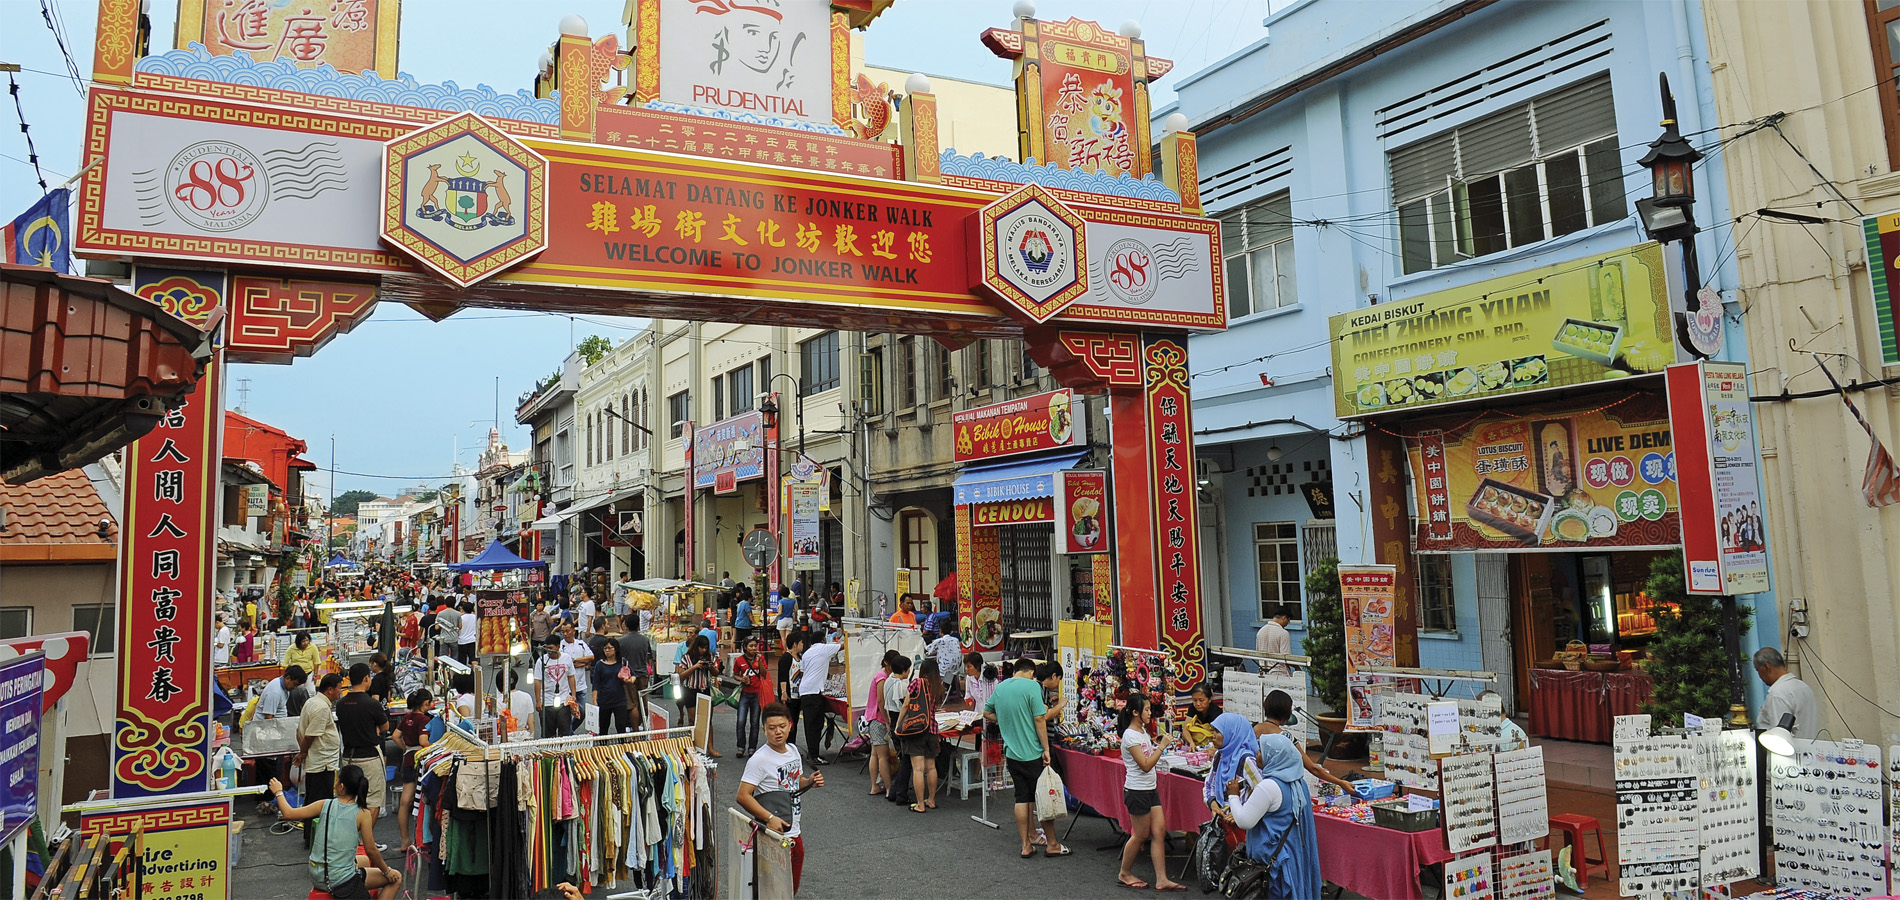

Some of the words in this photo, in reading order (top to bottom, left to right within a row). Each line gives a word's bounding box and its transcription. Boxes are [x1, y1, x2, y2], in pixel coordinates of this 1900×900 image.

[1066, 48, 1107, 67] 福貴門
[693, 84, 809, 117] PRUDENTIAL
[659, 123, 839, 156] 二零一二年壬辰龍年
[178, 146, 249, 167] PRUDENTIAL
[175, 158, 254, 211] 88
[580, 172, 677, 200] SELAMAT
[687, 183, 764, 209] DATANG
[773, 194, 797, 213] KE
[805, 197, 878, 222] JONKER
[886, 206, 933, 227] WALK
[203, 212, 253, 227] MALAYSIA
[210, 210, 236, 218] Years
[1008, 219, 1026, 242] MAJLIS
[1028, 217, 1064, 248] BANDARAYA
[604, 241, 722, 268] WELCOME
[732, 252, 761, 271] TO
[771, 256, 853, 279] JONKER
[861, 264, 919, 284] WALK
[1008, 253, 1028, 281] MELAKA
[1031, 259, 1065, 285] BERSEJARAH
[1110, 251, 1149, 289] 88
[1351, 313, 1381, 327] KEDAI
[1384, 302, 1425, 320] BISKUT
[1351, 325, 1390, 350] MEI
[1396, 306, 1474, 343] ZHONG
[1479, 289, 1551, 325] YUAN
[1353, 336, 1452, 365] CONFECTIONERY
[1457, 329, 1489, 345] SDN.
[1494, 322, 1528, 337] BHD.
[976, 408, 1000, 420] MAKANAN
[1001, 401, 1028, 415] TEMPATAN
[973, 421, 1000, 442] Bibik
[1012, 416, 1047, 435] House
[1477, 445, 1497, 455] LOTUS
[1498, 442, 1523, 453] BISCUIT
[1588, 436, 1625, 454] LIVE
[1590, 461, 1629, 482] 现做
[987, 485, 1005, 498] BIBIK
[1006, 483, 1030, 496] HOUSE
[1073, 486, 1103, 497] Cendol
[978, 502, 1046, 523] CENDOL
[1620, 495, 1660, 516] 现卖
[478, 598, 505, 608] Curry
[975, 598, 1001, 608] Cendol
[14, 670, 42, 696] PERINGATAN
[1616, 717, 1627, 725] RM
